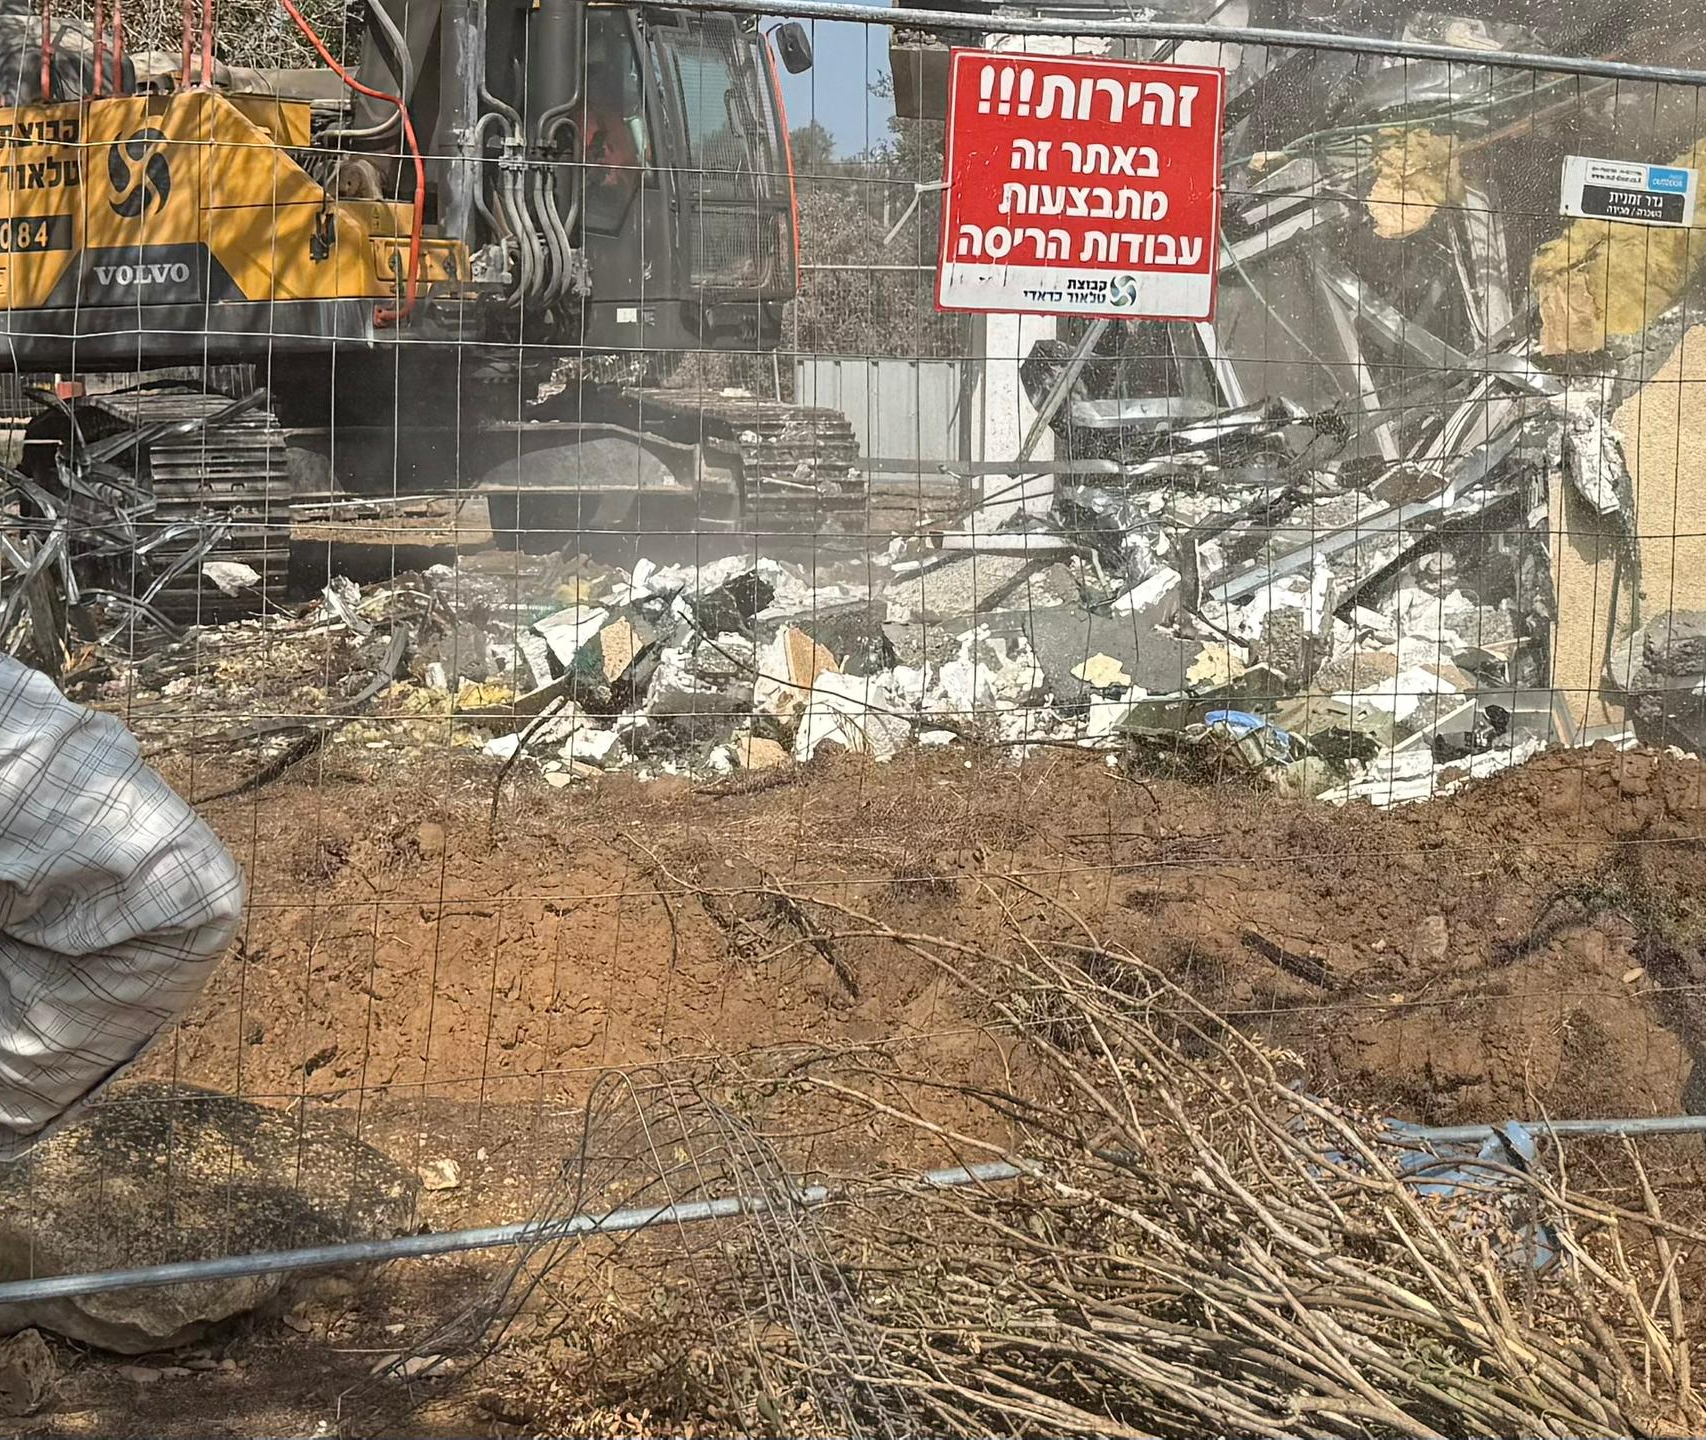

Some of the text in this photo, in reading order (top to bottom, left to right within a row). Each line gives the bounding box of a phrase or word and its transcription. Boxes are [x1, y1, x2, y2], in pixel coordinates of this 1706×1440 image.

[978, 65, 1199, 127] זהירות!!!
[0, 156, 81, 190] טלאור
[1011, 139, 1159, 177] באתר זה
[998, 182, 1168, 220] מתבצעות
[1609, 191, 1663, 207] גדר זמנית
[958, 225, 1203, 266] עבודות הריסה
[94, 262, 190, 286] VOLVO
[1067, 279, 1107, 291] קבוצת
[1067, 291, 1106, 304] טלאור
